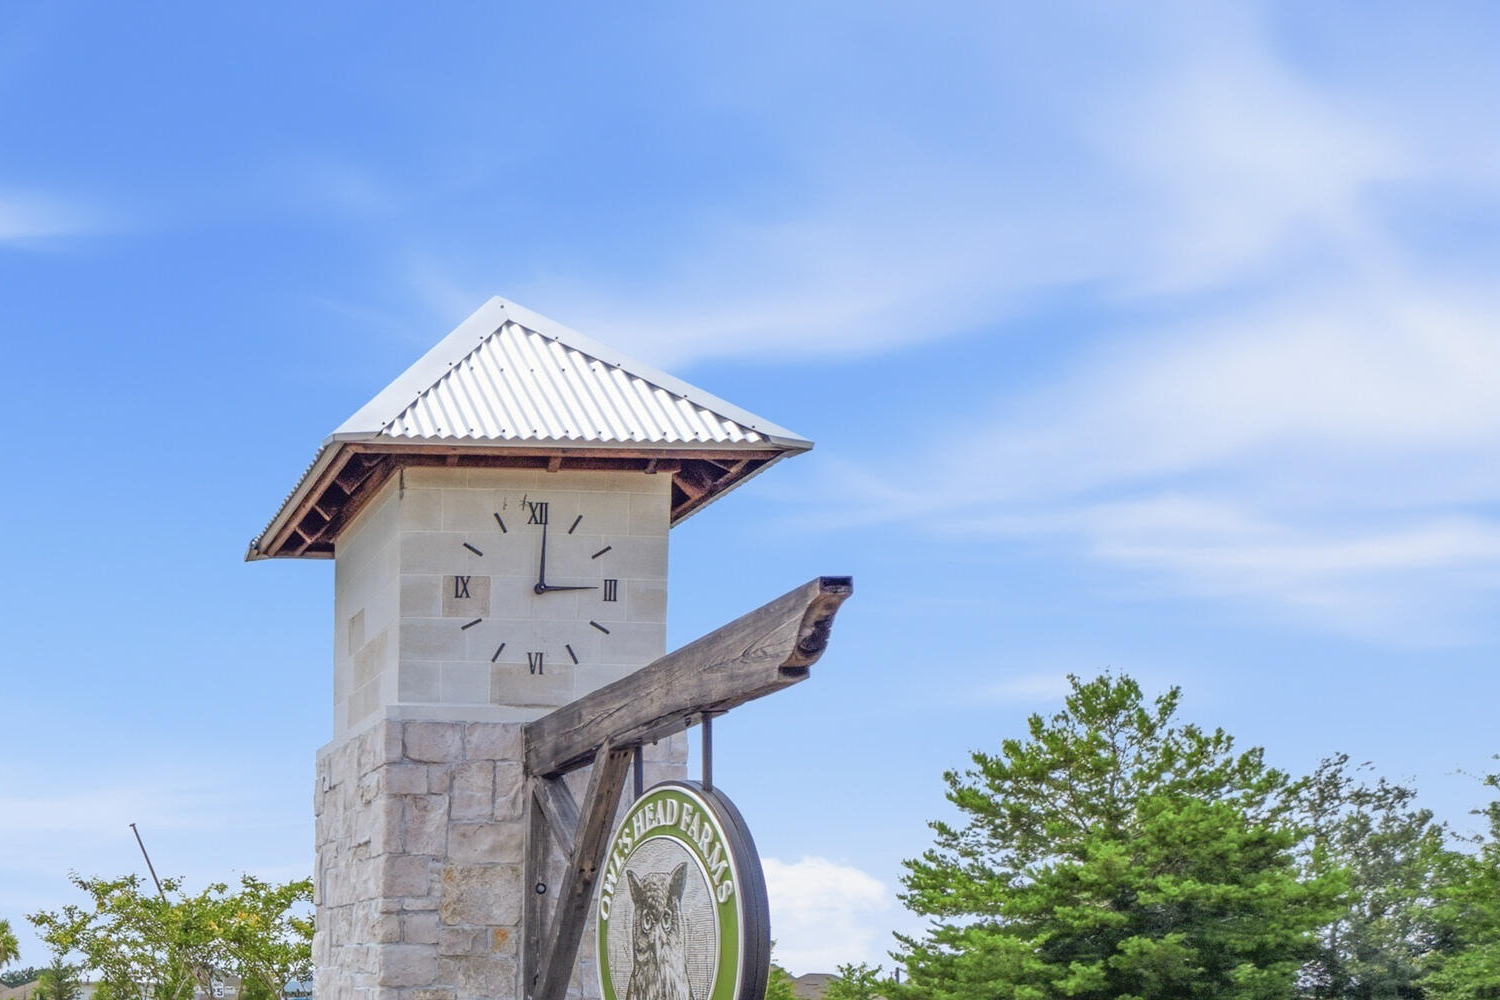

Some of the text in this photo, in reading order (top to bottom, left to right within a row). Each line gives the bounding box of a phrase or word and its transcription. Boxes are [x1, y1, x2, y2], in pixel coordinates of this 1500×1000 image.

[527, 502, 549, 525] XII
[454, 576, 471, 598] IX
[603, 579, 618, 602] III
[527, 652, 544, 675] VI
[600, 798, 735, 921] OWL'S HEAD FARMS
